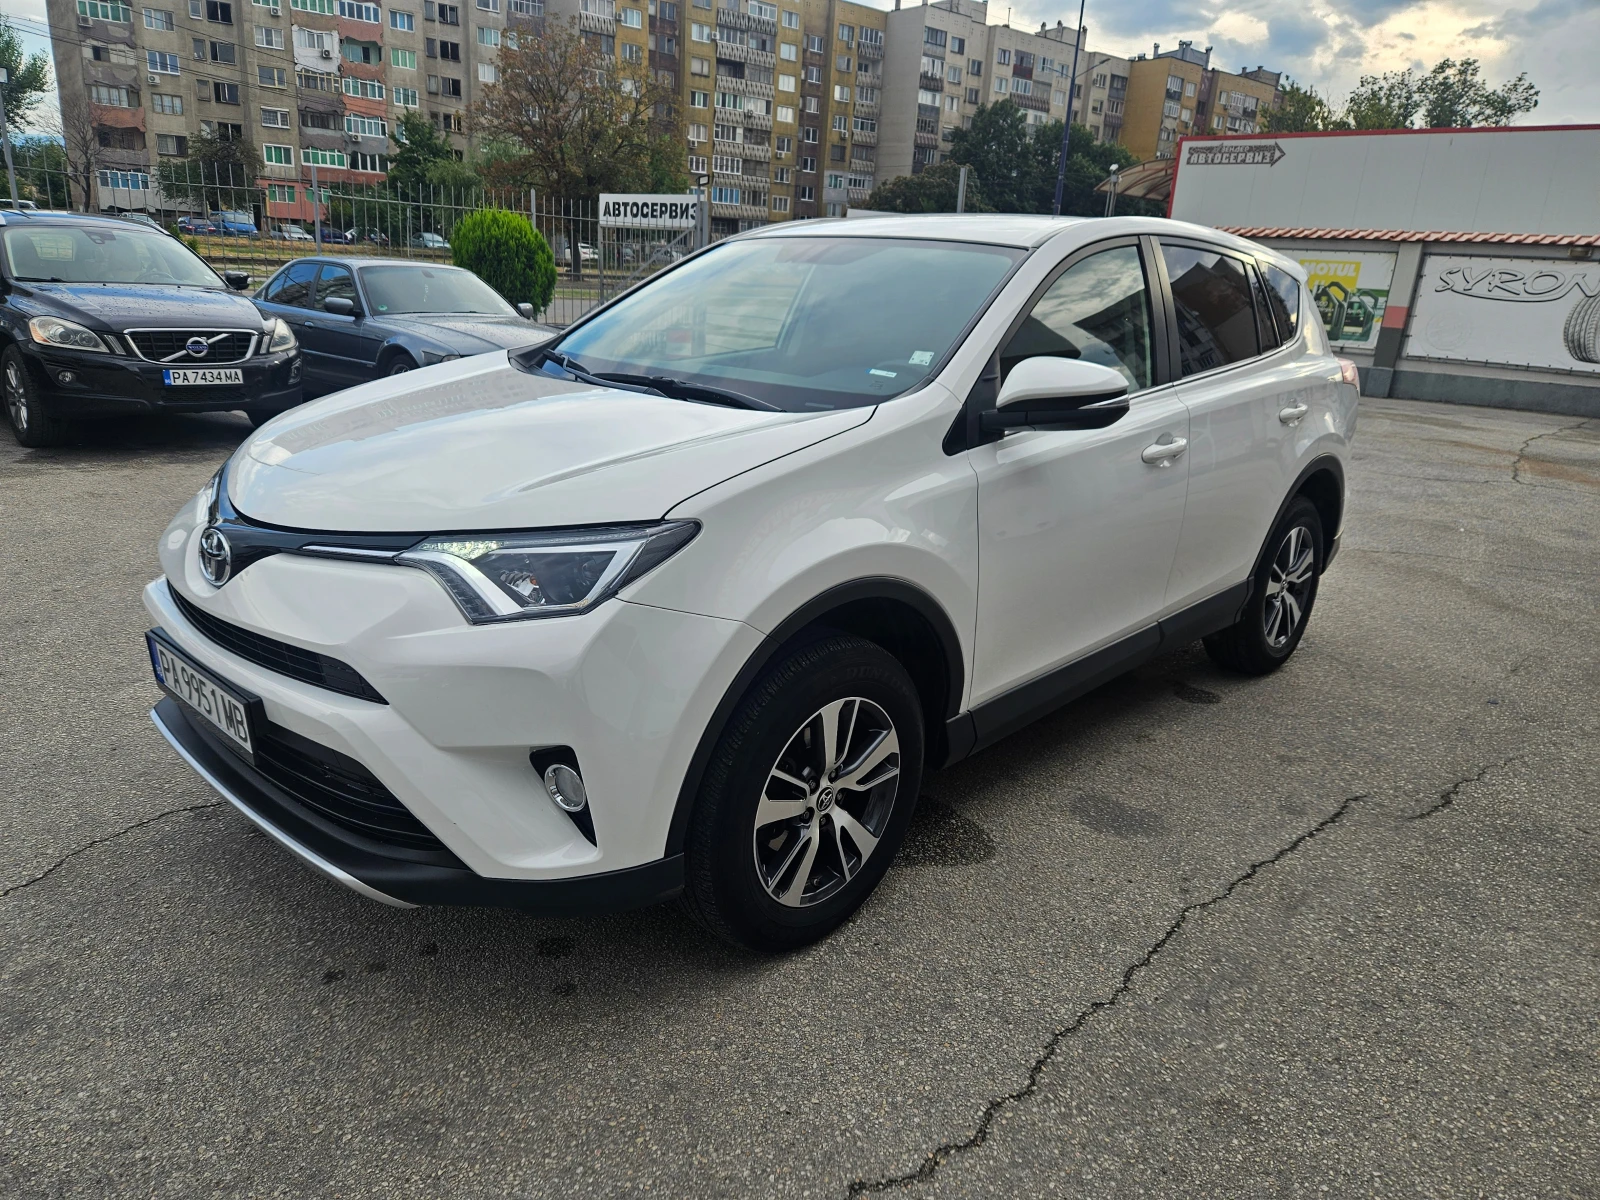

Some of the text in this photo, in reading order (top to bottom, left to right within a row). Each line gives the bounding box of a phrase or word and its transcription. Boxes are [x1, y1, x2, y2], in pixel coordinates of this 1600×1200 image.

[1190, 151, 1271, 164] АВТОСЕРВИЗ
[603, 201, 698, 220] АВТОСЕРВИЗ
[1302, 262, 1357, 277] MOTUL
